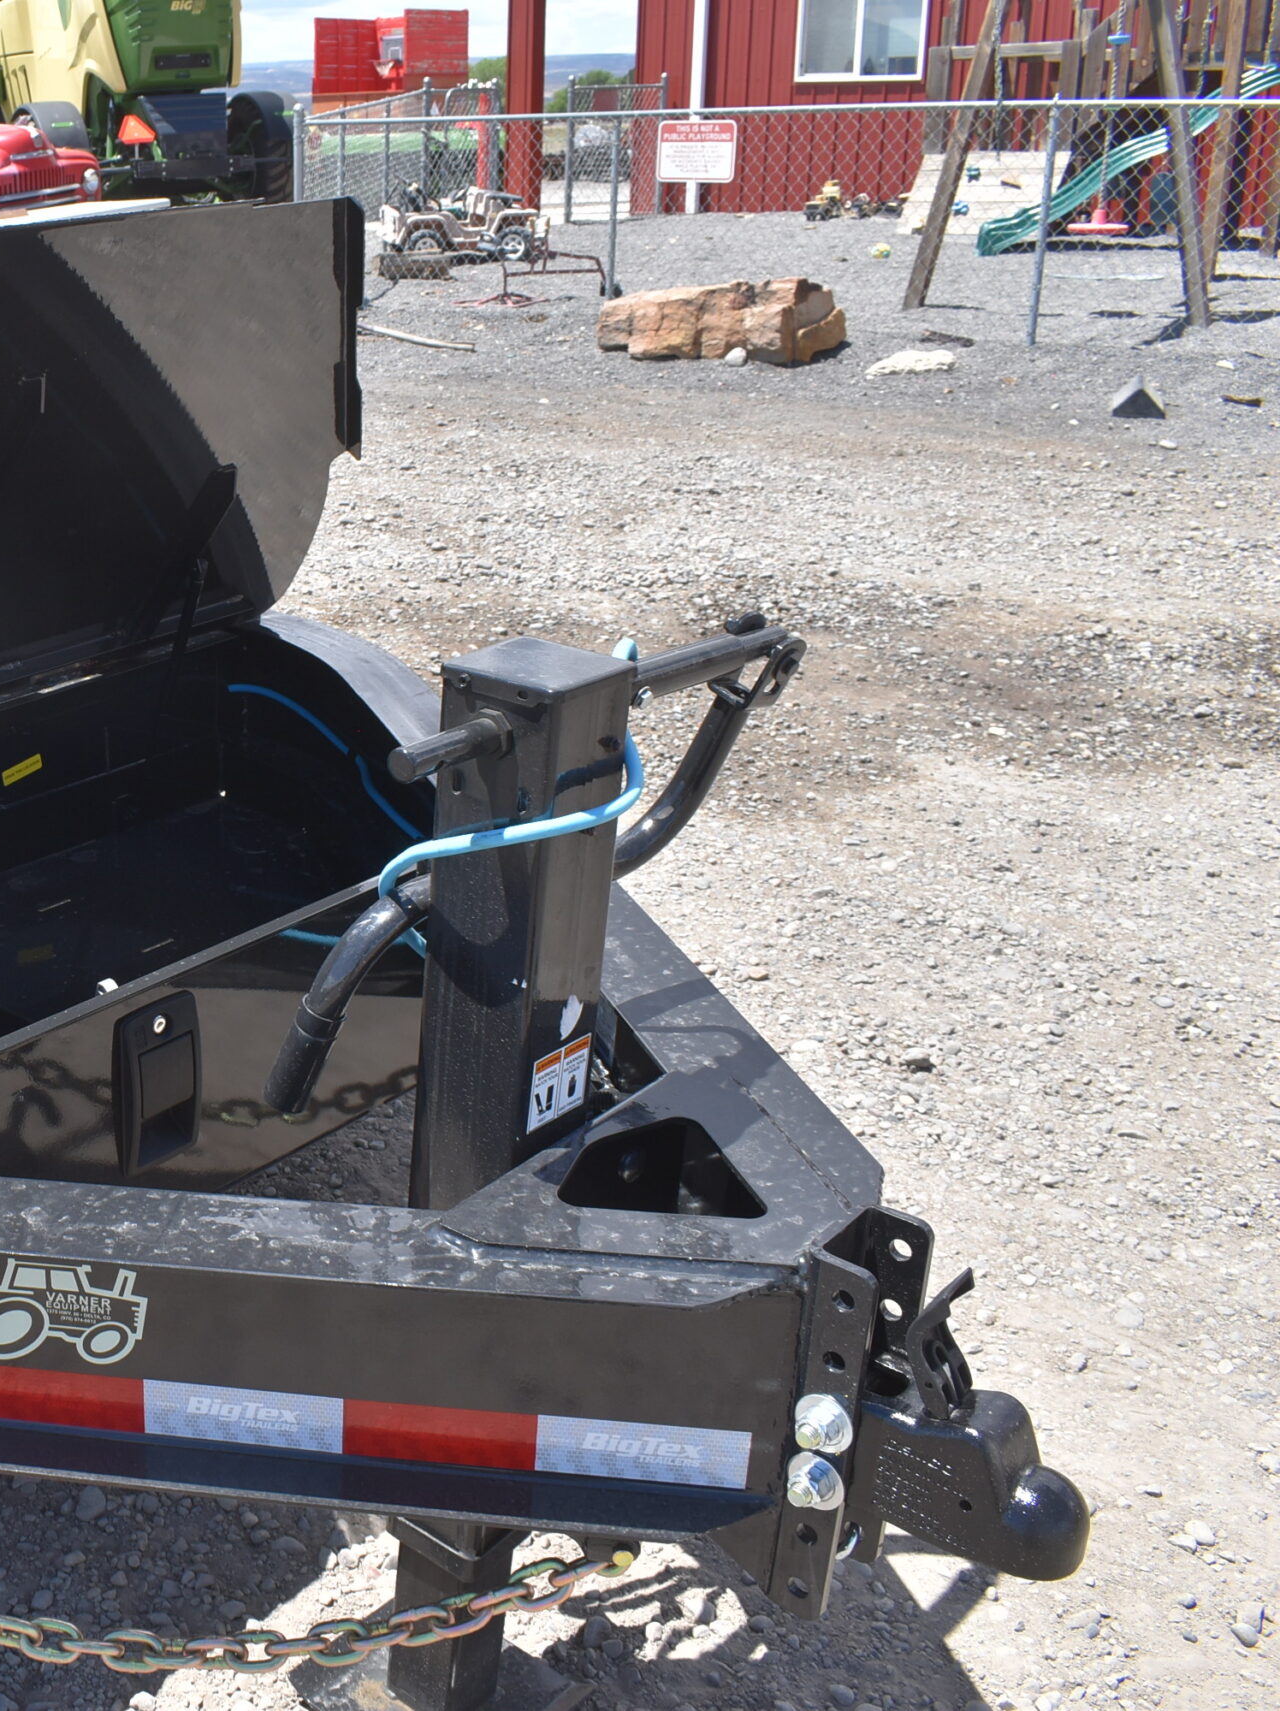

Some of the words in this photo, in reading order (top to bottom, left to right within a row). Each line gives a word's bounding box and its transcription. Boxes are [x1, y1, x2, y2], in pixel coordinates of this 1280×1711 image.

[676, 124, 690, 132] THIS
[691, 124, 699, 132] IS
[700, 124, 713, 132] NOT
[714, 124, 720, 132] A
[663, 133, 687, 141] PUBLIC
[688, 133, 732, 141] PLAYGROUND
[46, 1291, 111, 1309] VARNER
[45, 1300, 112, 1315] EQUIPMENT
[186, 1396, 300, 1424] BigTex
[240, 1420, 300, 1432] TRAILERS
[582, 1432, 702, 1459] BigTex
[638, 1455, 701, 1467] TRAILERS
